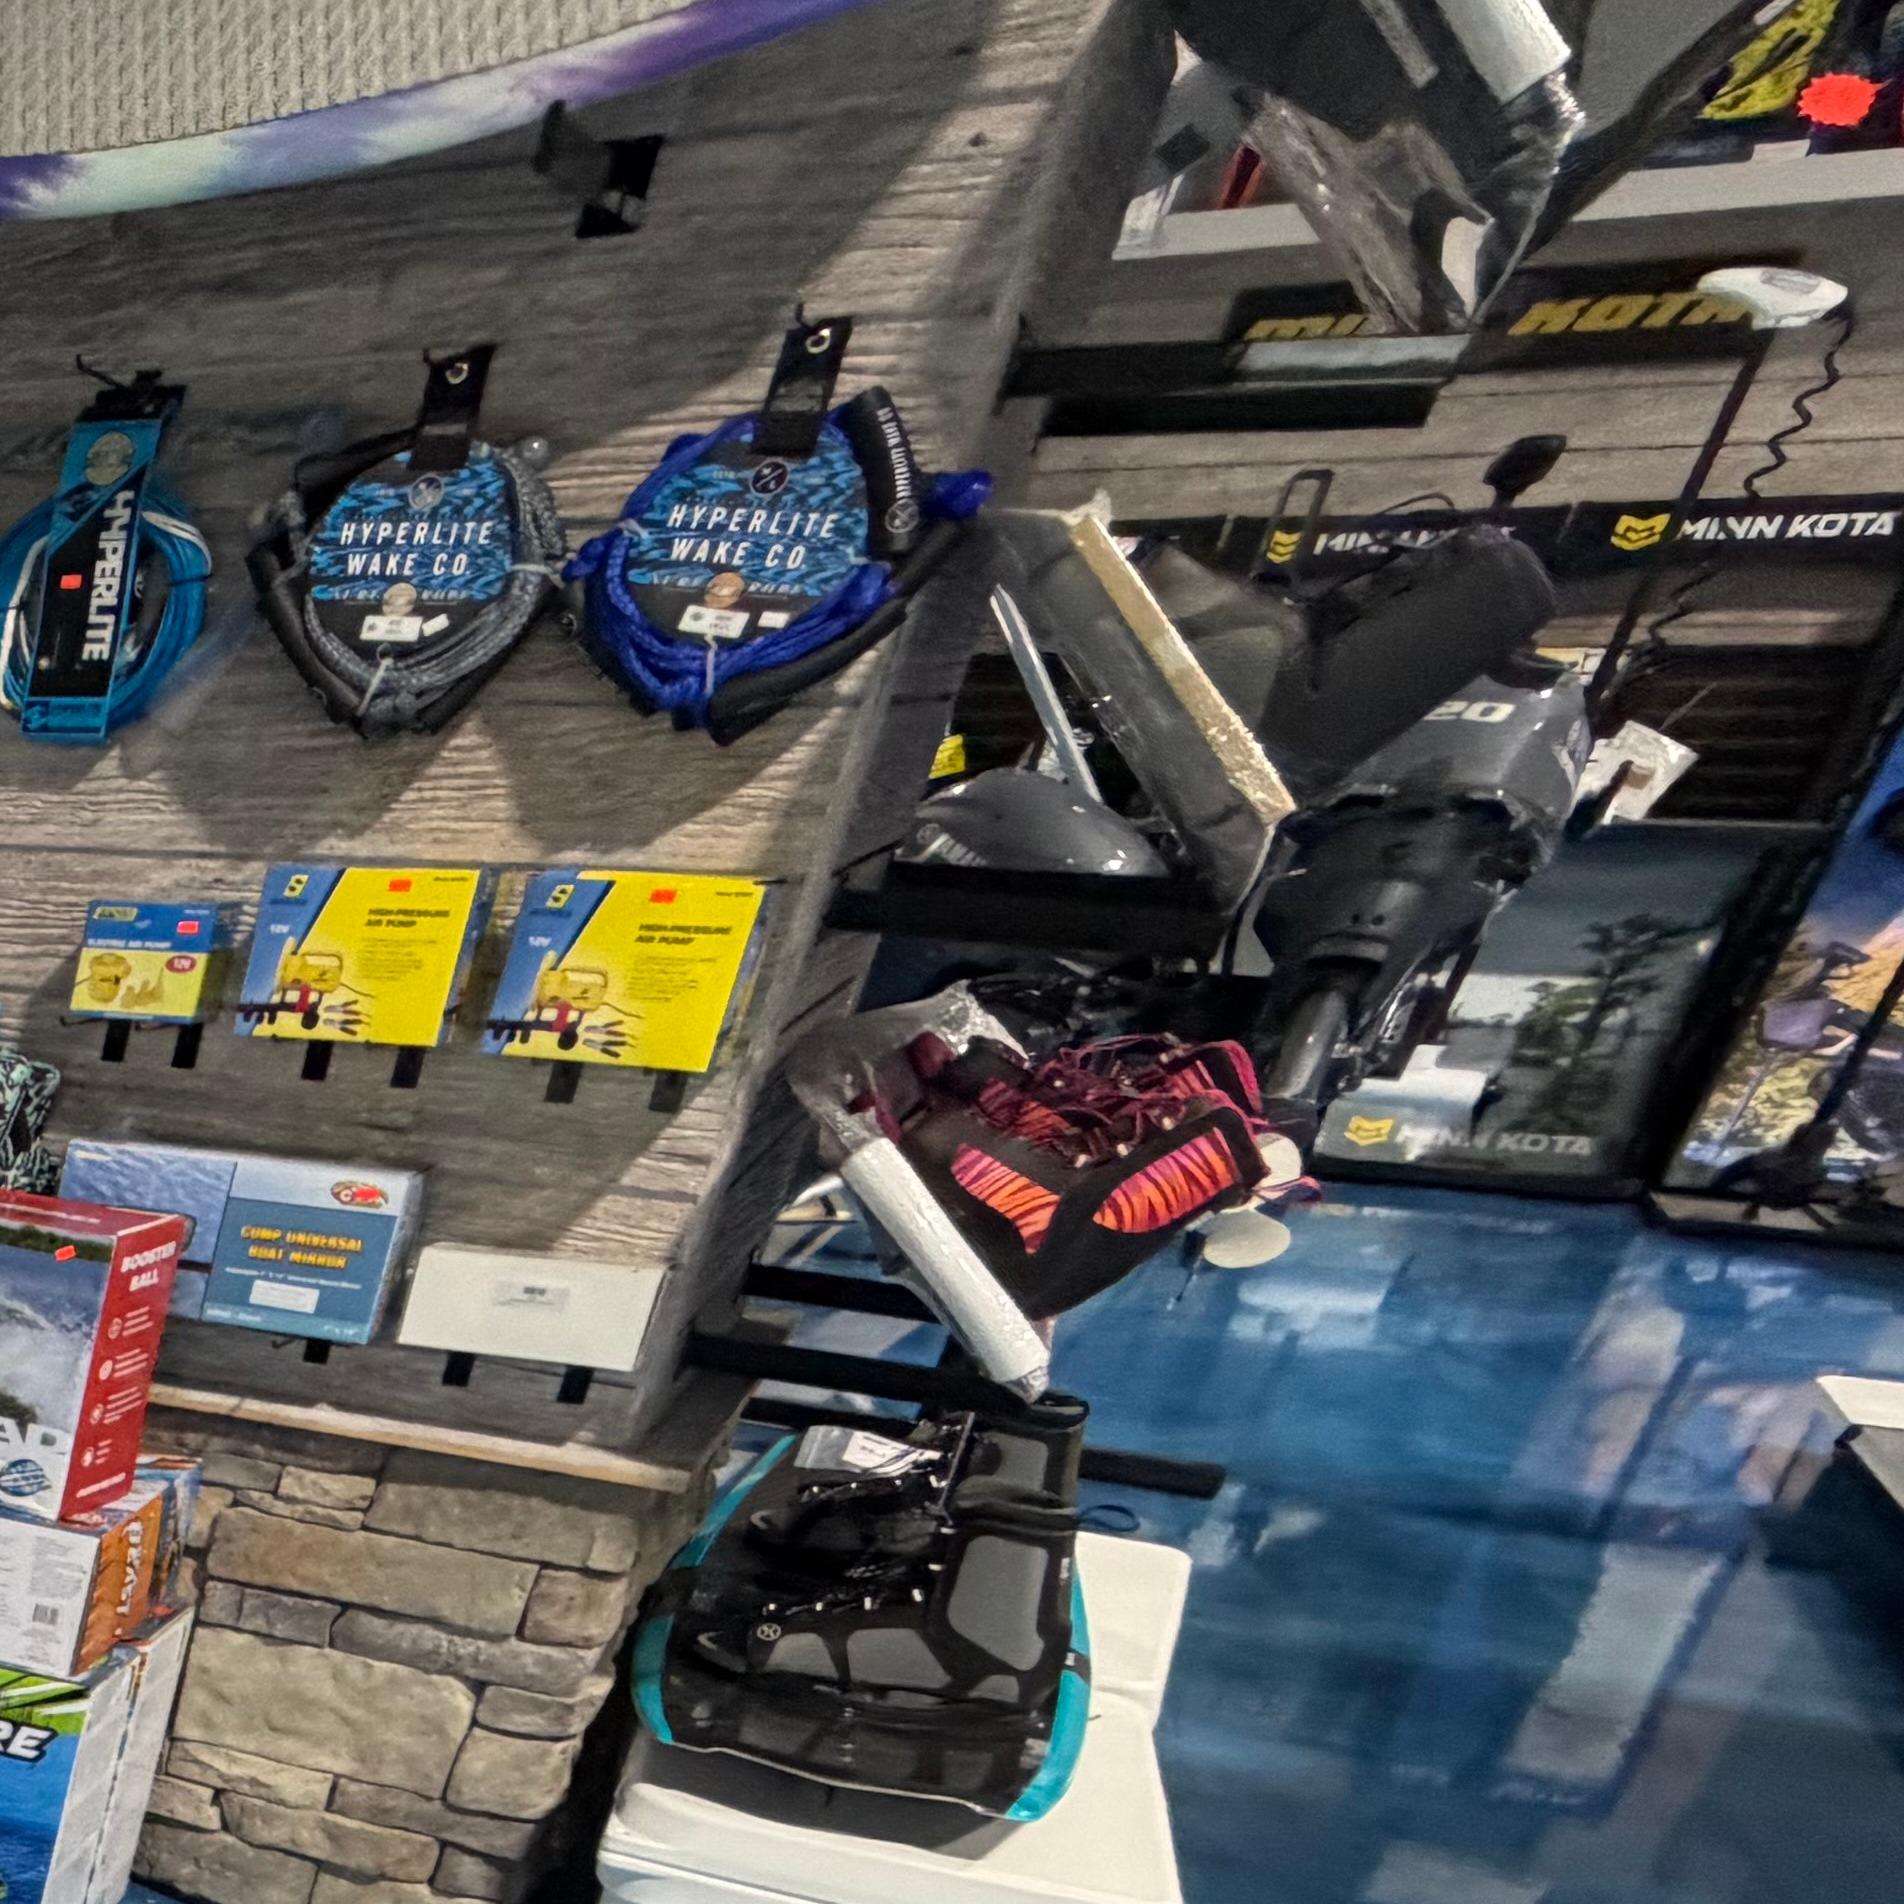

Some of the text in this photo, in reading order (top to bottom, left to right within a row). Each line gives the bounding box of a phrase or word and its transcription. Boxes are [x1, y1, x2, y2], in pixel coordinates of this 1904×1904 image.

[340, 520, 496, 545] HYPERLITE
[667, 503, 841, 539] HYPERLITE
[1784, 510, 1901, 539] KOTA
[346, 552, 419, 576] WAKE
[670, 537, 752, 566] WAKE
[82, 490, 135, 661] HYPERLITE
[120, 1240, 177, 1273] BOOSTER
[129, 1268, 159, 1292] BALL
